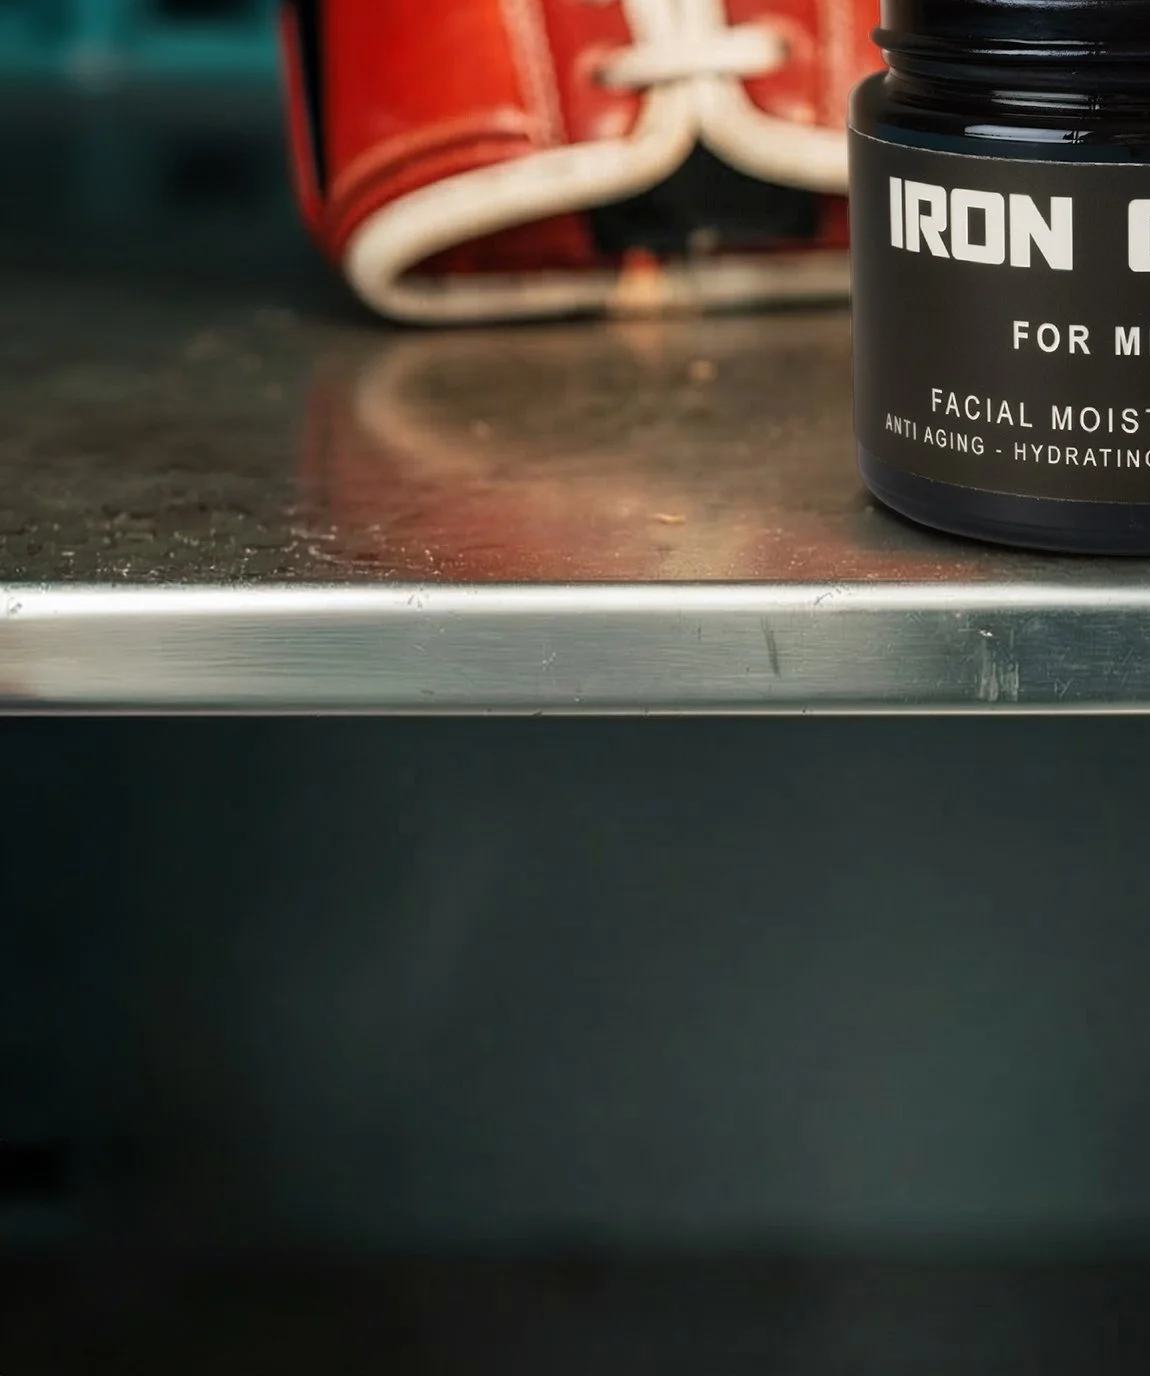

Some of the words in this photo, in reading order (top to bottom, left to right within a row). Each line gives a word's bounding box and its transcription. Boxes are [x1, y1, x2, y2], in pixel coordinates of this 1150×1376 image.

[889, 176, 1074, 271] IRON
[1012, 320, 1091, 355] FOR
[931, 387, 1033, 428] FACIAL
[885, 412, 917, 441] ANTI
[923, 426, 985, 456] AGING
